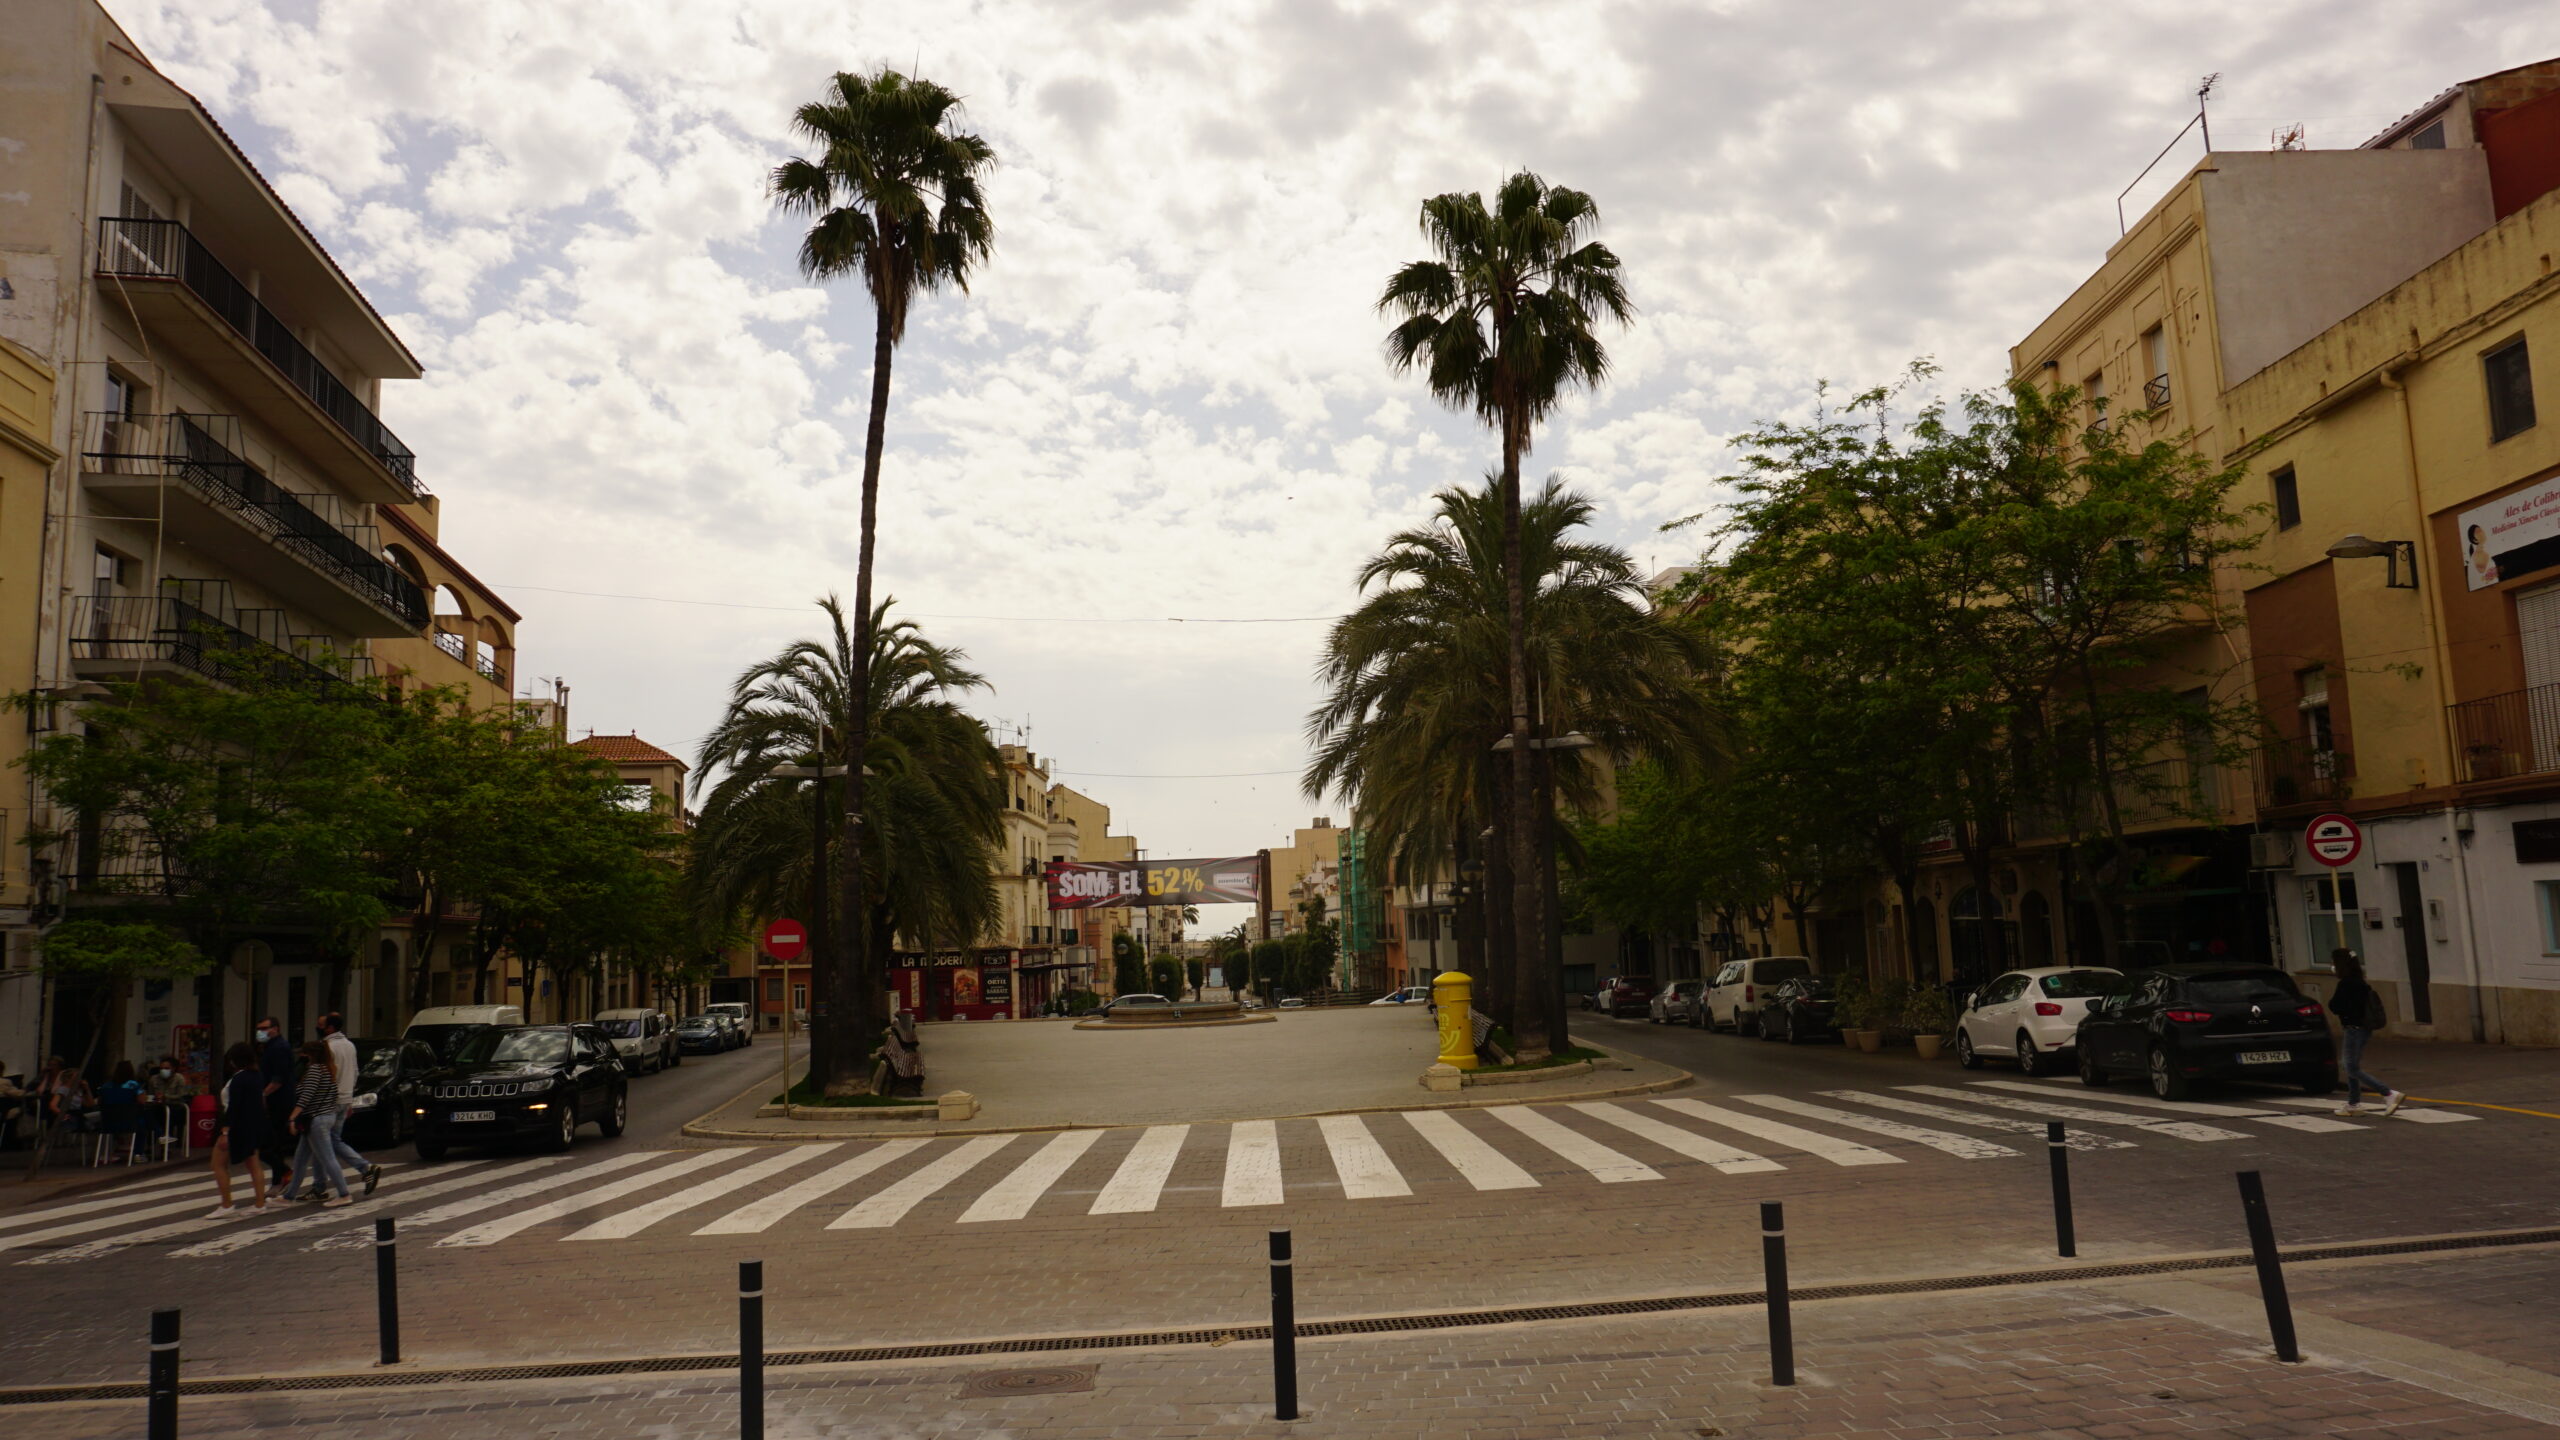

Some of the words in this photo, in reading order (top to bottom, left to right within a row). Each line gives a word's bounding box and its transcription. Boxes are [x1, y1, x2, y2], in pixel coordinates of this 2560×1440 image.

[2504, 506, 2520, 518] Ales
[2522, 500, 2532, 512] de
[2492, 521, 2517, 534] Medicina
[2519, 514, 2539, 525] Xinesa
[1119, 869, 1142, 896] EL
[1148, 867, 1205, 897] 52%
[902, 956, 915, 967] LA
[2244, 1052, 2268, 1062] 1428
[455, 1112, 475, 1121] 3214
[478, 1111, 494, 1120] KHD
